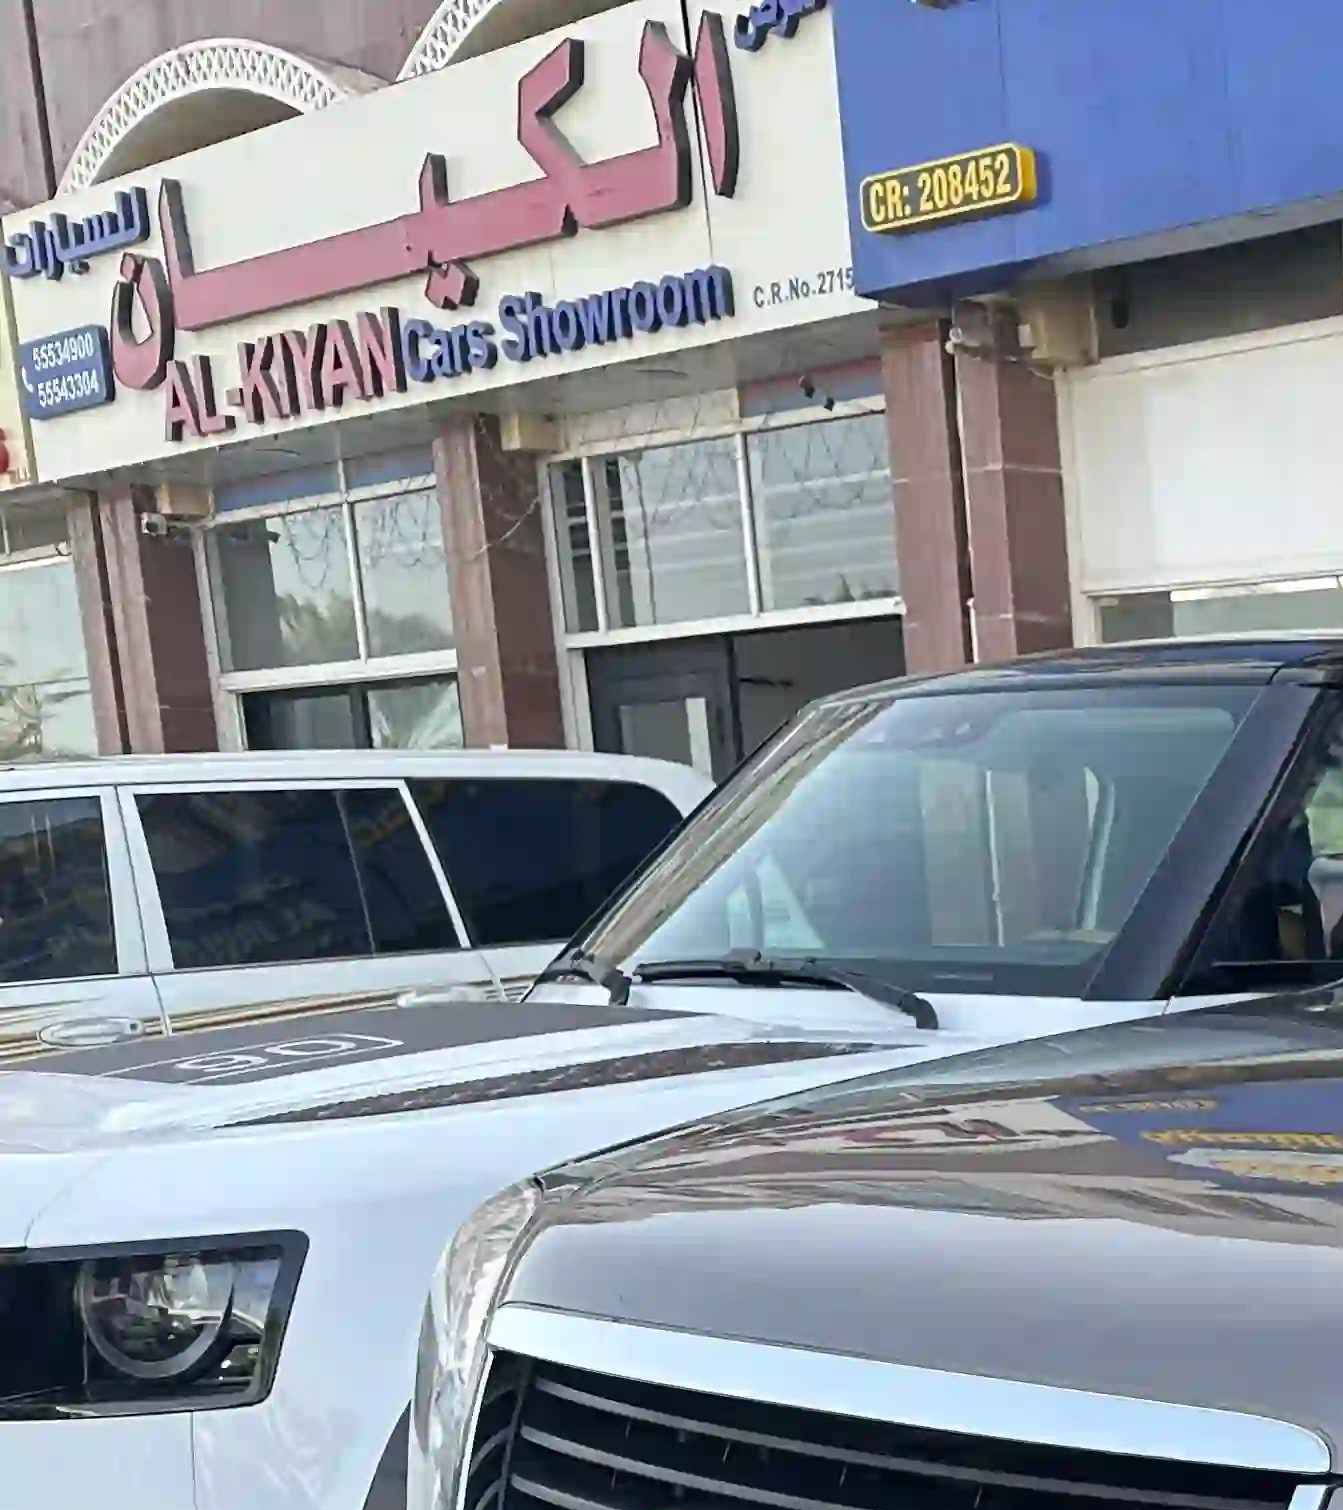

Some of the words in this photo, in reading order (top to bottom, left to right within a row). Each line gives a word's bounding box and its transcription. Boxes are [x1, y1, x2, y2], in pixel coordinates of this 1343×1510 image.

[868, 179, 913, 223] CR:
[917, 152, 1012, 212] 208452
[32, 331, 94, 371] 55534900
[164, 306, 408, 442] AL-KIYAN
[401, 318, 498, 382] Cars
[498, 264, 735, 362] Showroom
[37, 368, 100, 409] 55543304
